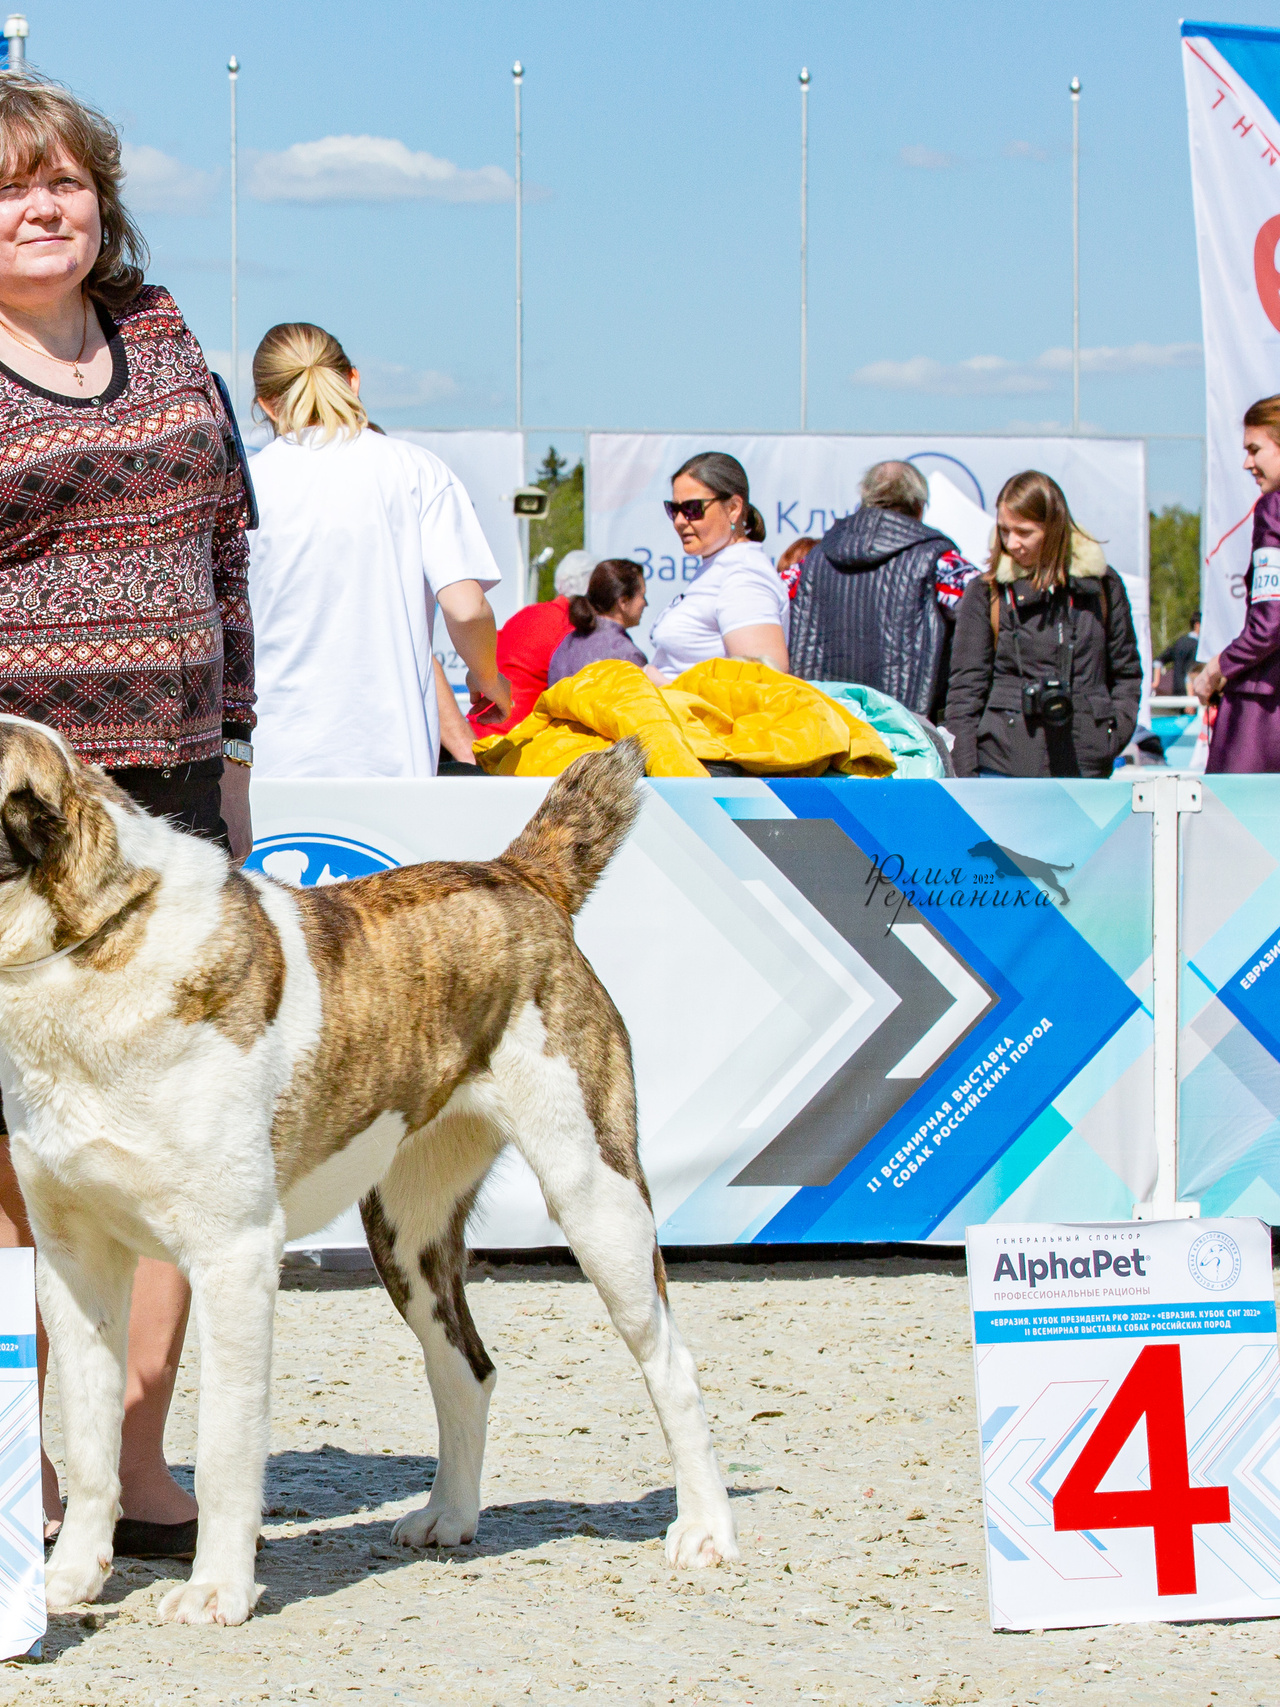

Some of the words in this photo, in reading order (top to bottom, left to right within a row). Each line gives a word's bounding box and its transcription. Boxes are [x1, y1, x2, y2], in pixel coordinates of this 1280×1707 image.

[892, 1144, 934, 1188] СОБАК
[932, 1062, 1011, 1146] РОССИЙСКИХ
[1009, 1017, 1053, 1064] ПОРОД
[866, 1176, 882, 1193] II
[880, 1101, 953, 1179] ВСЕМИРНАЯ
[951, 1036, 1015, 1103] ВЫСТАВКА
[996, 1234, 1080, 1244] ГЕНЕРАЛЬНЫЙ
[1088, 1233, 1141, 1242] СПОНСОР
[994, 1288, 1100, 1301] ПРОФЕССИОНАЛЬНЫЕ
[1103, 1287, 1150, 1298] РАЦИОНЫ
[1033, 1316, 1058, 1324] КУБОК
[1061, 1314, 1110, 1324] ПРЕЗИДЕНТА
[1112, 1313, 1128, 1321] РКФ
[1199, 1310, 1224, 1318] КУБОК
[1227, 1309, 1240, 1317] СНГ
[1032, 1326, 1078, 1336] ВСЕМИРНАЯ
[1081, 1325, 1122, 1334] ВЫСТАВКА
[1124, 1323, 1149, 1332] СОБАК
[1151, 1321, 1202, 1330] РОССИЙСКИХ
[1204, 1320, 1231, 1328] ПОРОД
[1052, 1343, 1231, 1597] 4
